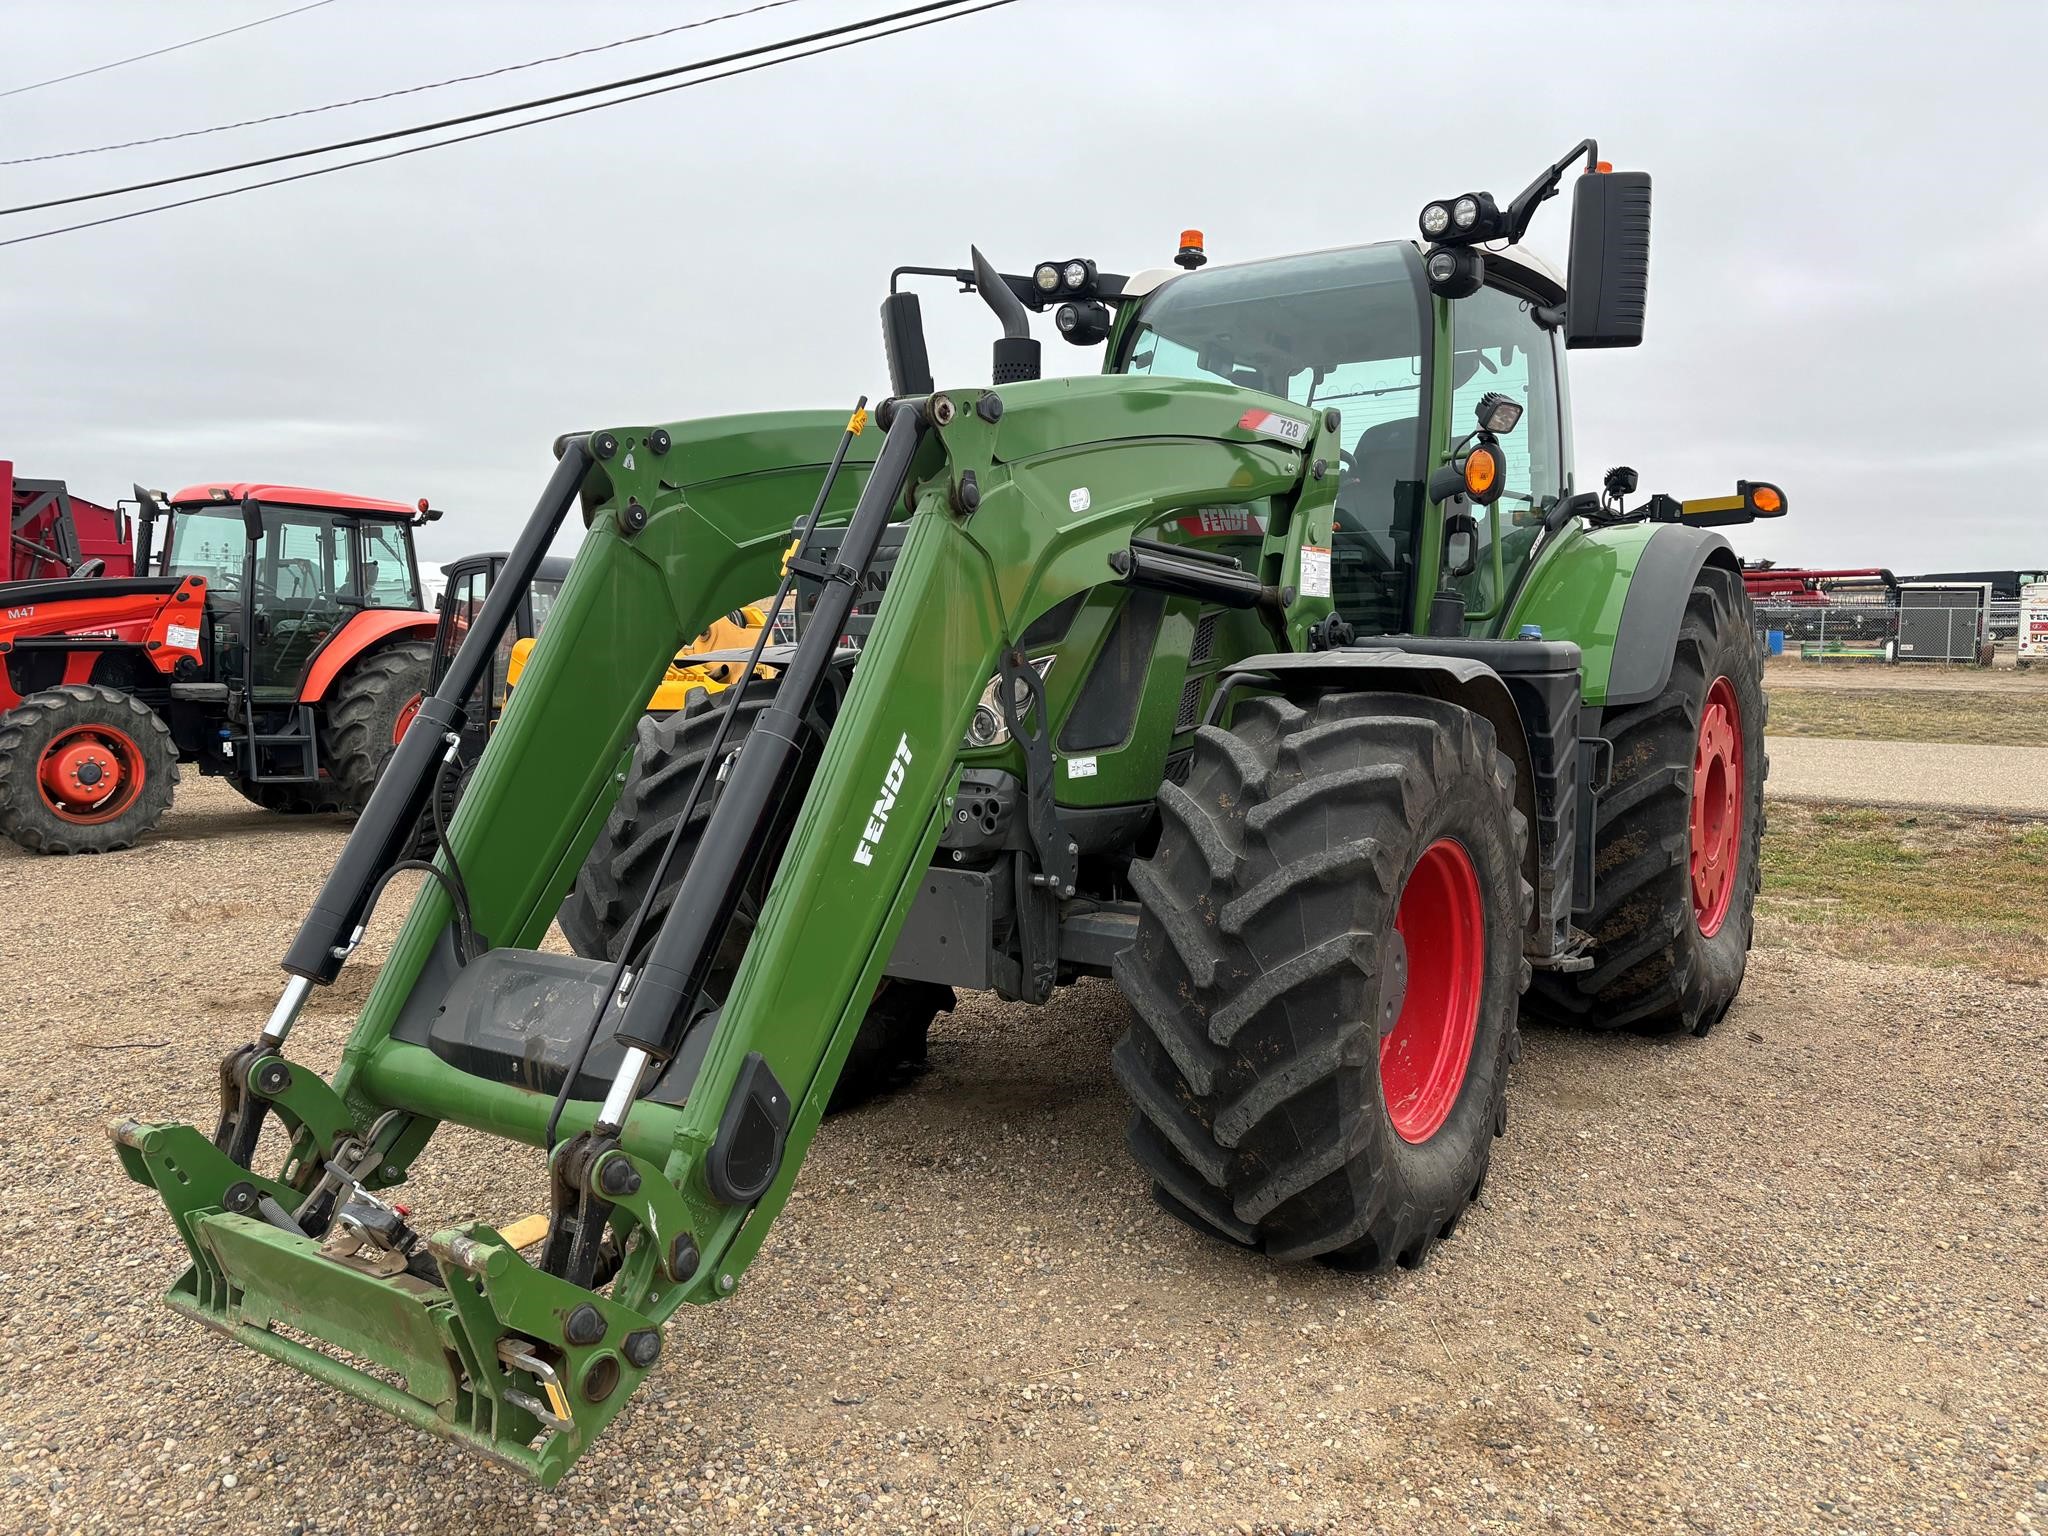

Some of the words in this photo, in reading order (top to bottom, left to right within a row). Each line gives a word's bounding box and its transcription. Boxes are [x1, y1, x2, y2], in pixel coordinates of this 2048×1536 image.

[1280, 419, 1299, 438] 728
[1198, 509, 1249, 532] FENDT
[8, 606, 35, 619] M47
[853, 731, 912, 867] FENDT
